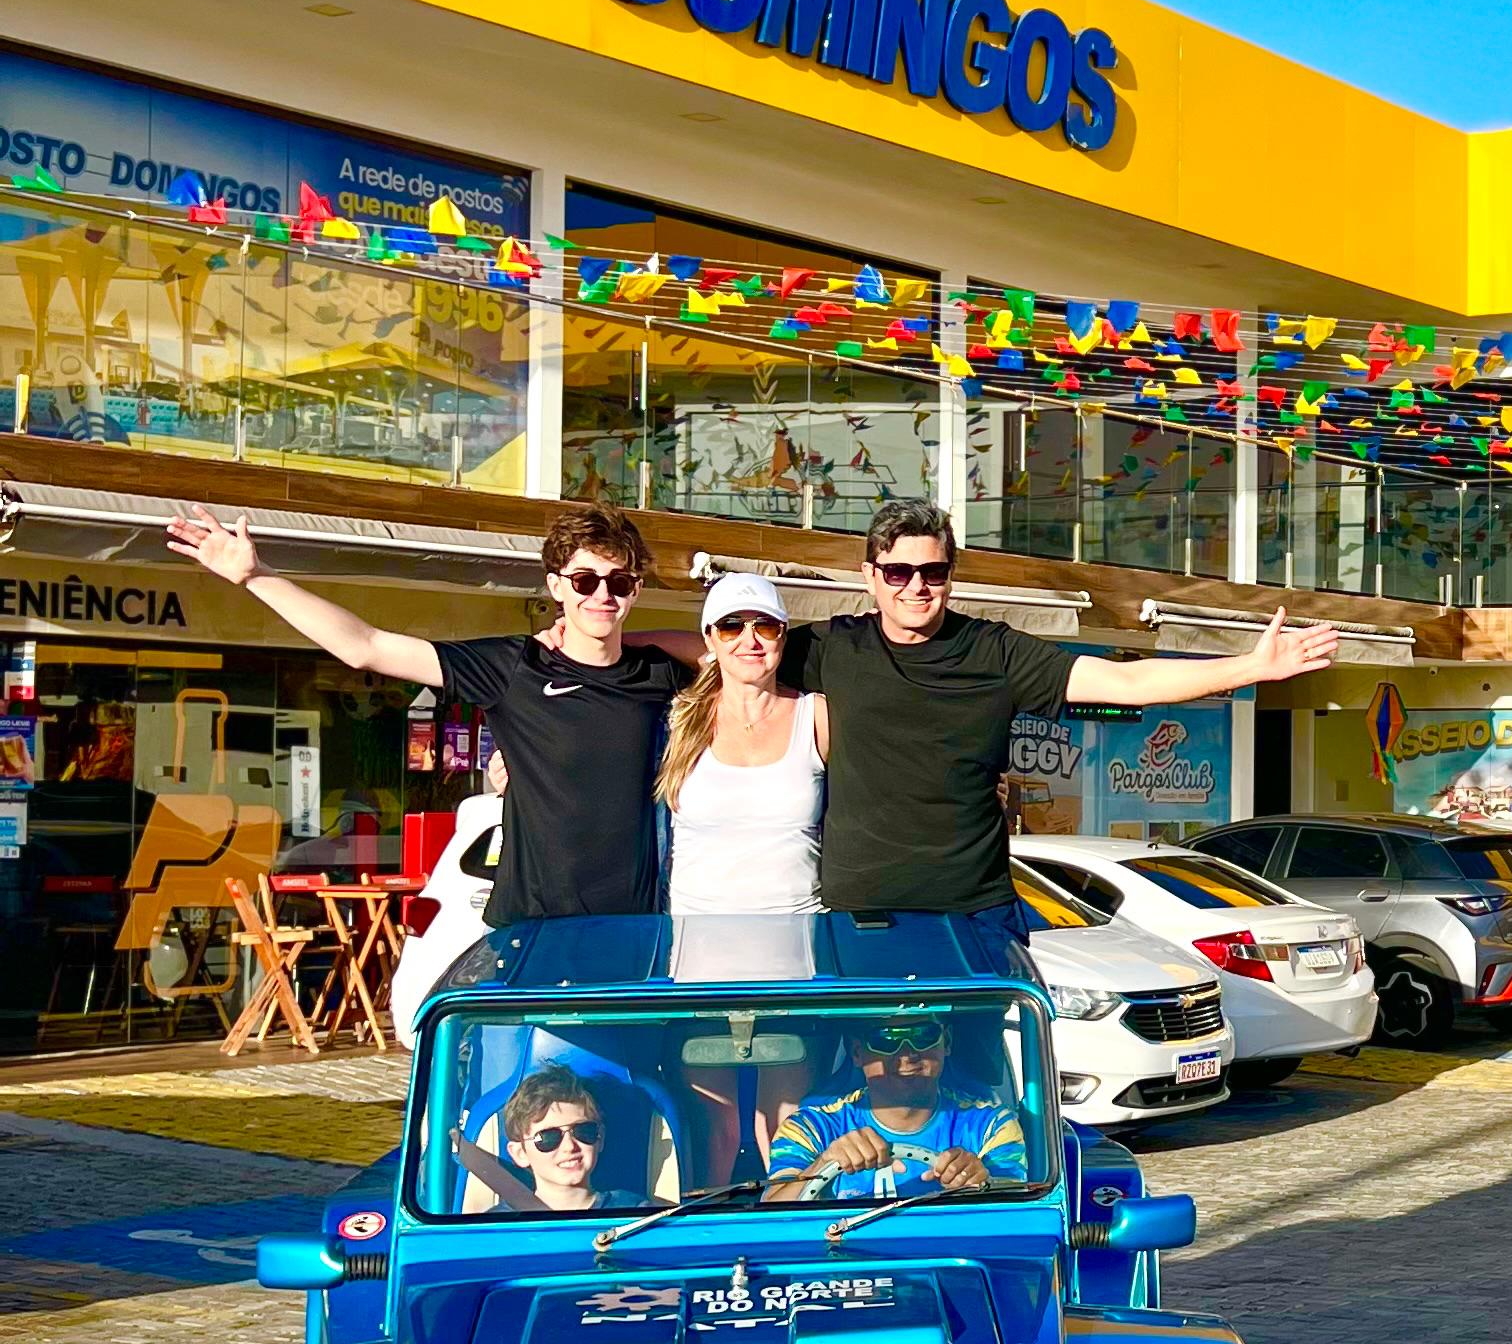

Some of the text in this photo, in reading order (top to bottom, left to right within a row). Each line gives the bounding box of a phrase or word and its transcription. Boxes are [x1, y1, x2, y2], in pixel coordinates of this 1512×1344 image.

[110, 151, 281, 214] DOMNGOS
[339, 158, 355, 182] A
[359, 165, 405, 192] rede
[408, 173, 435, 198] de
[338, 191, 381, 219] que
[0, 574, 187, 627] ENIÊNCIA
[1050, 723, 1070, 741] DE
[1393, 720, 1491, 762] SSEIO
[1009, 737, 1082, 777] GGY
[692, 1277, 894, 1304] RIO GRANDE
[707, 1287, 874, 1314] DO NORTE
